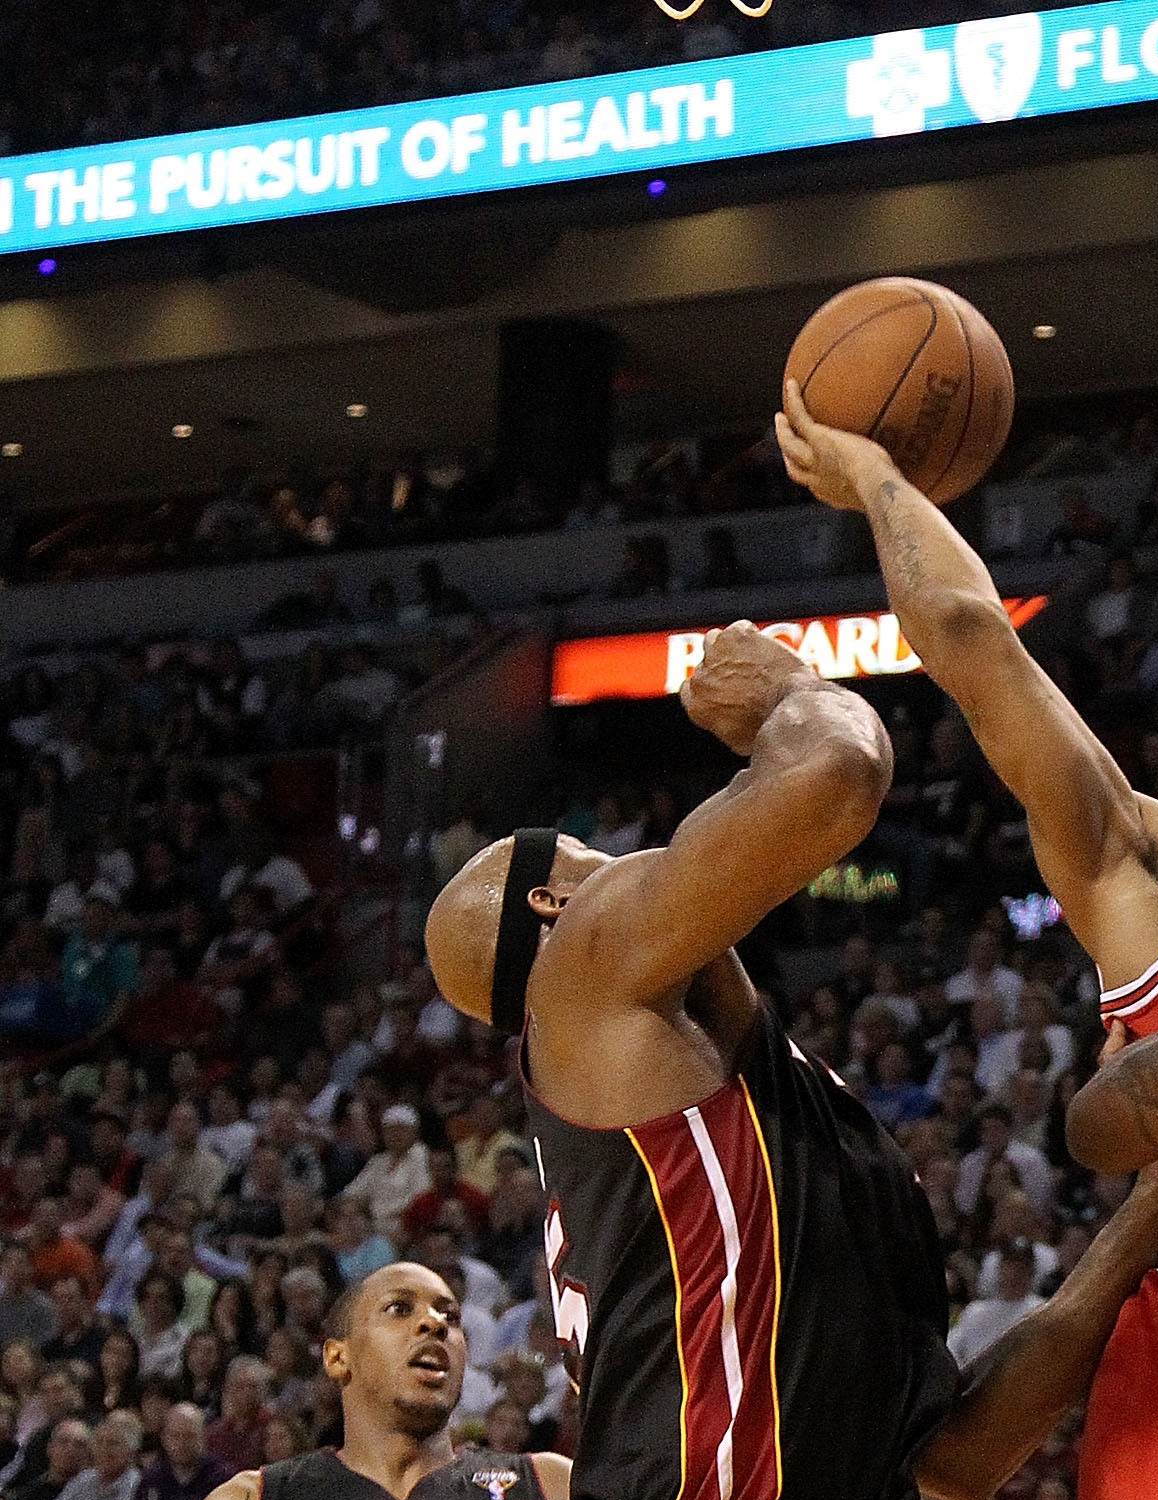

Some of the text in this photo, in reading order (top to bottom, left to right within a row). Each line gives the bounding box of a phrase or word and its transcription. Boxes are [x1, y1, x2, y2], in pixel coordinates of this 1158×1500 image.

[24, 160, 138, 229] THE
[149, 126, 391, 214] PURSUIT
[400, 113, 488, 179] OF
[501, 78, 734, 167] HEALTH
